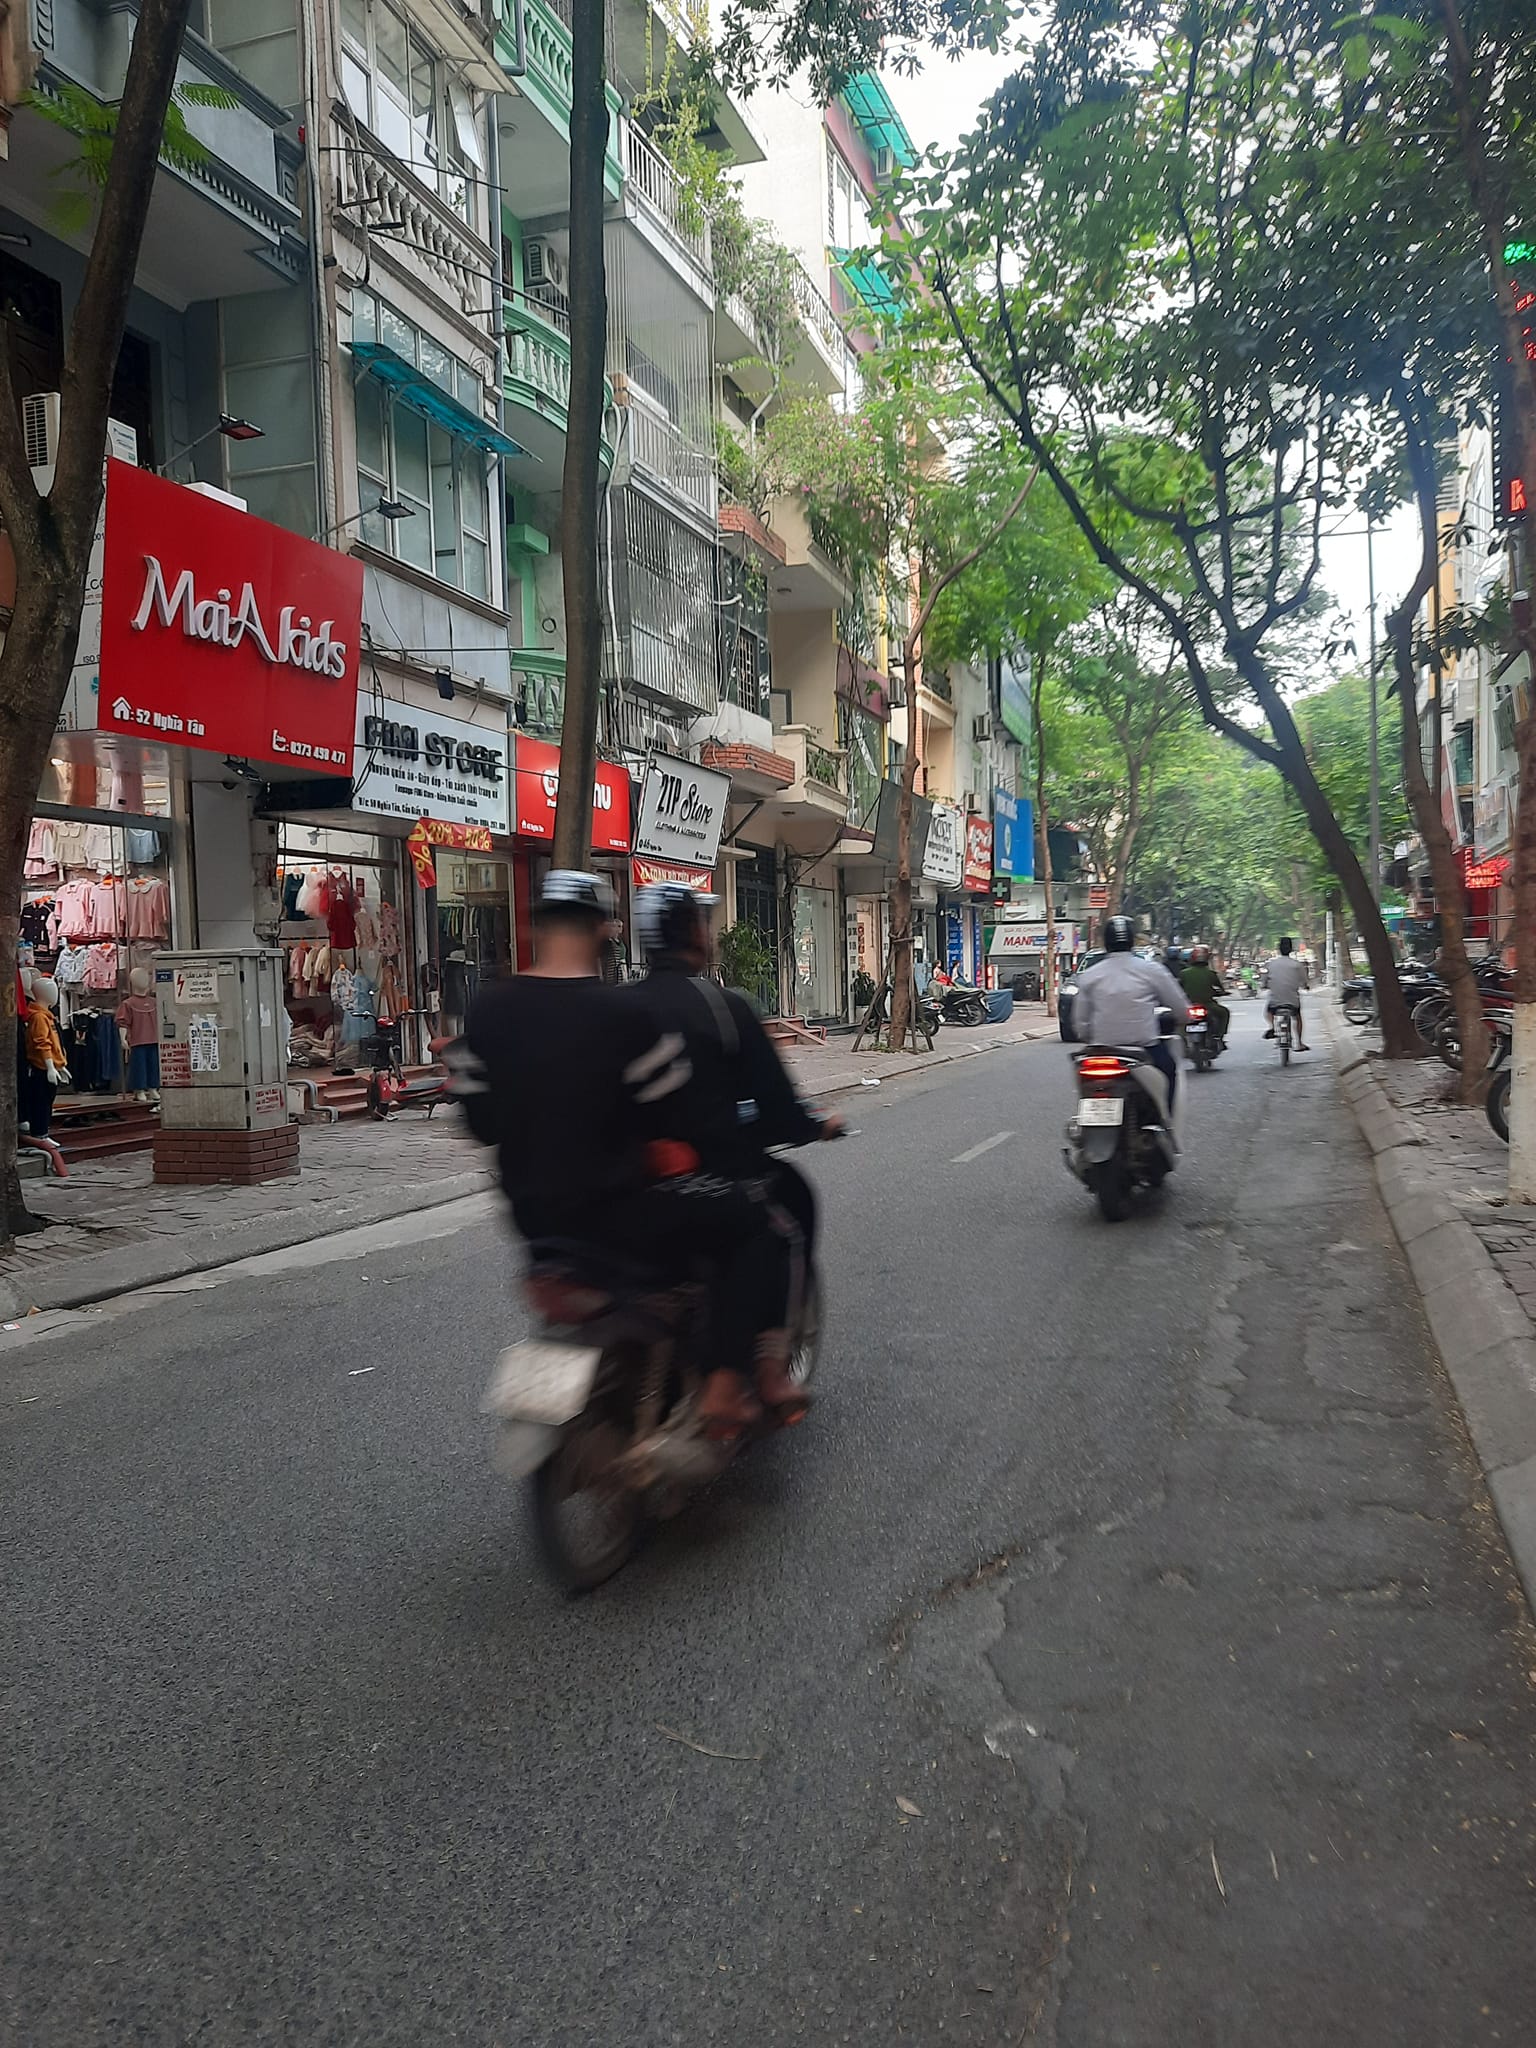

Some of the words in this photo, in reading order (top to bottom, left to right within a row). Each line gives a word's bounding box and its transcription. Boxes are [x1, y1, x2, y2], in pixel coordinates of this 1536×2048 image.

[277, 606, 346, 680] kids
[136, 708, 151, 725] 52
[153, 711, 183, 732] Nghĩa
[186, 718, 205, 736] Tân
[289, 741, 312, 757] 0373
[331, 750, 346, 765] 471
[425, 732, 503, 782] STORE
[680, 783, 714, 824] Store
